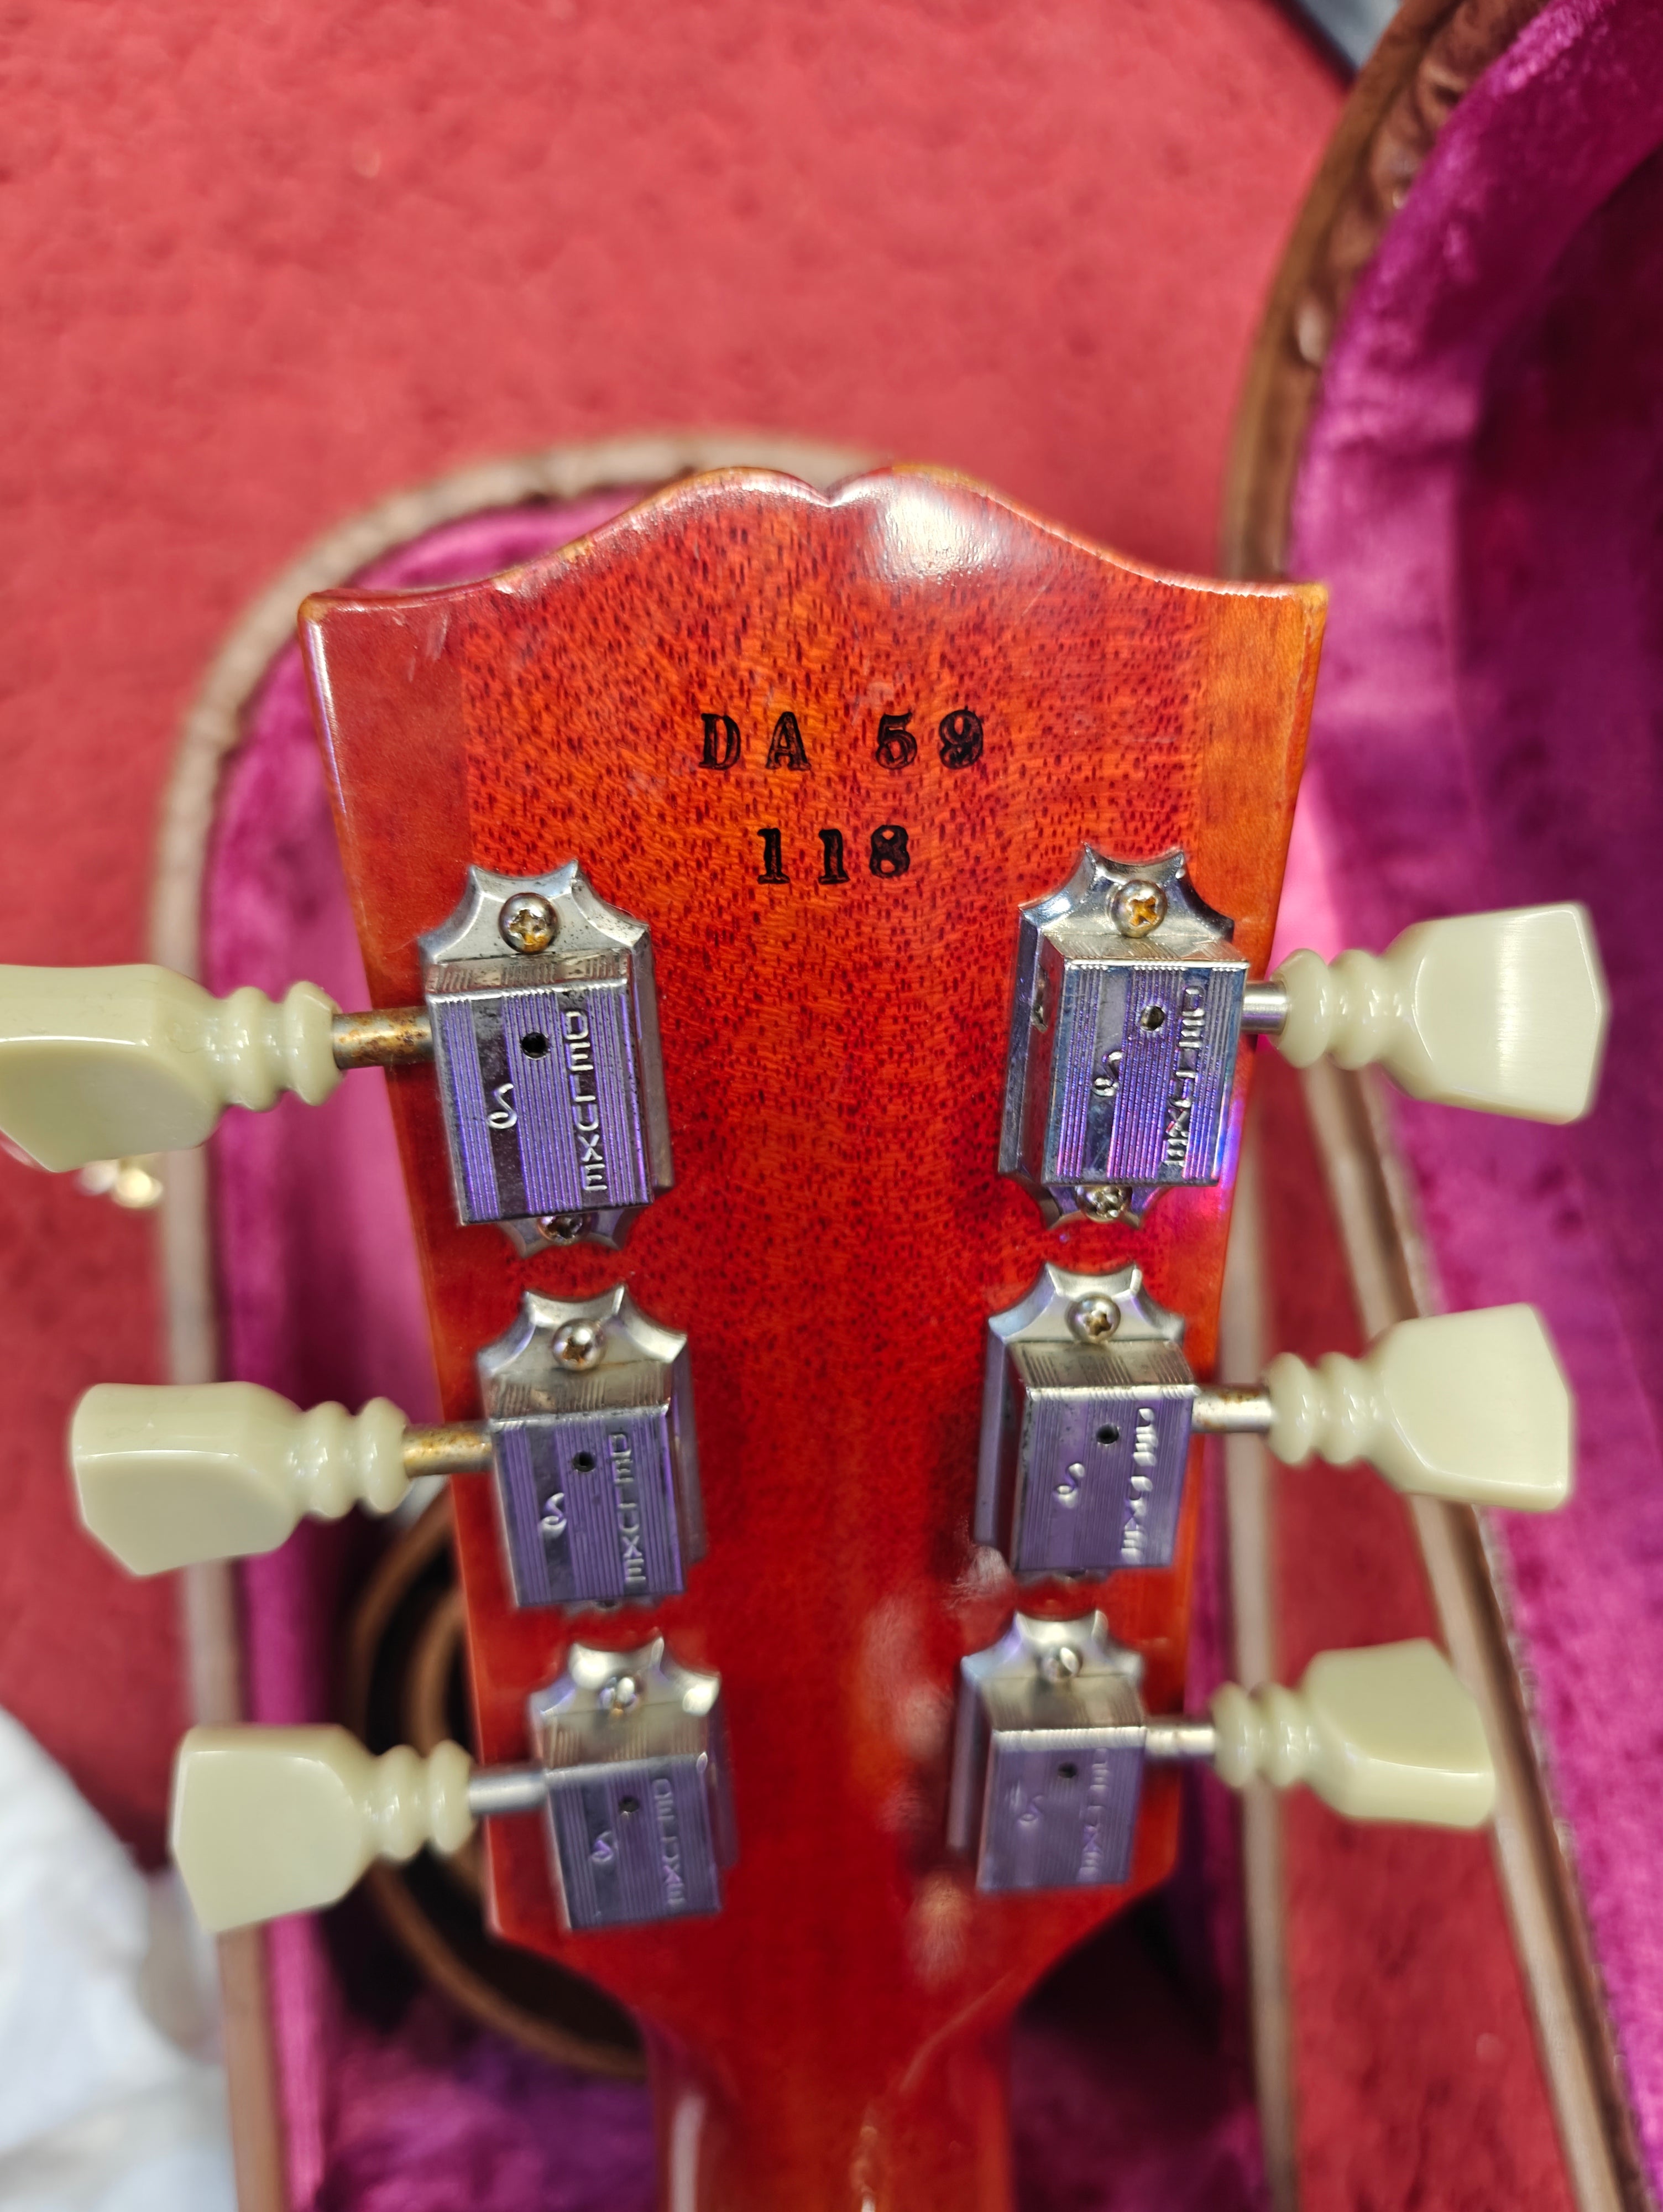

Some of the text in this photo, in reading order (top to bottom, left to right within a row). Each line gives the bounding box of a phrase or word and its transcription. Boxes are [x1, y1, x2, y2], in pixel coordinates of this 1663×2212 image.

[699, 708, 984, 771] DA 59
[757, 825, 911, 885] 118
[561, 1010, 608, 1191] DELUXE
[1162, 985, 1205, 1167] DELUXE
[610, 1433, 646, 1583] DELUXE
